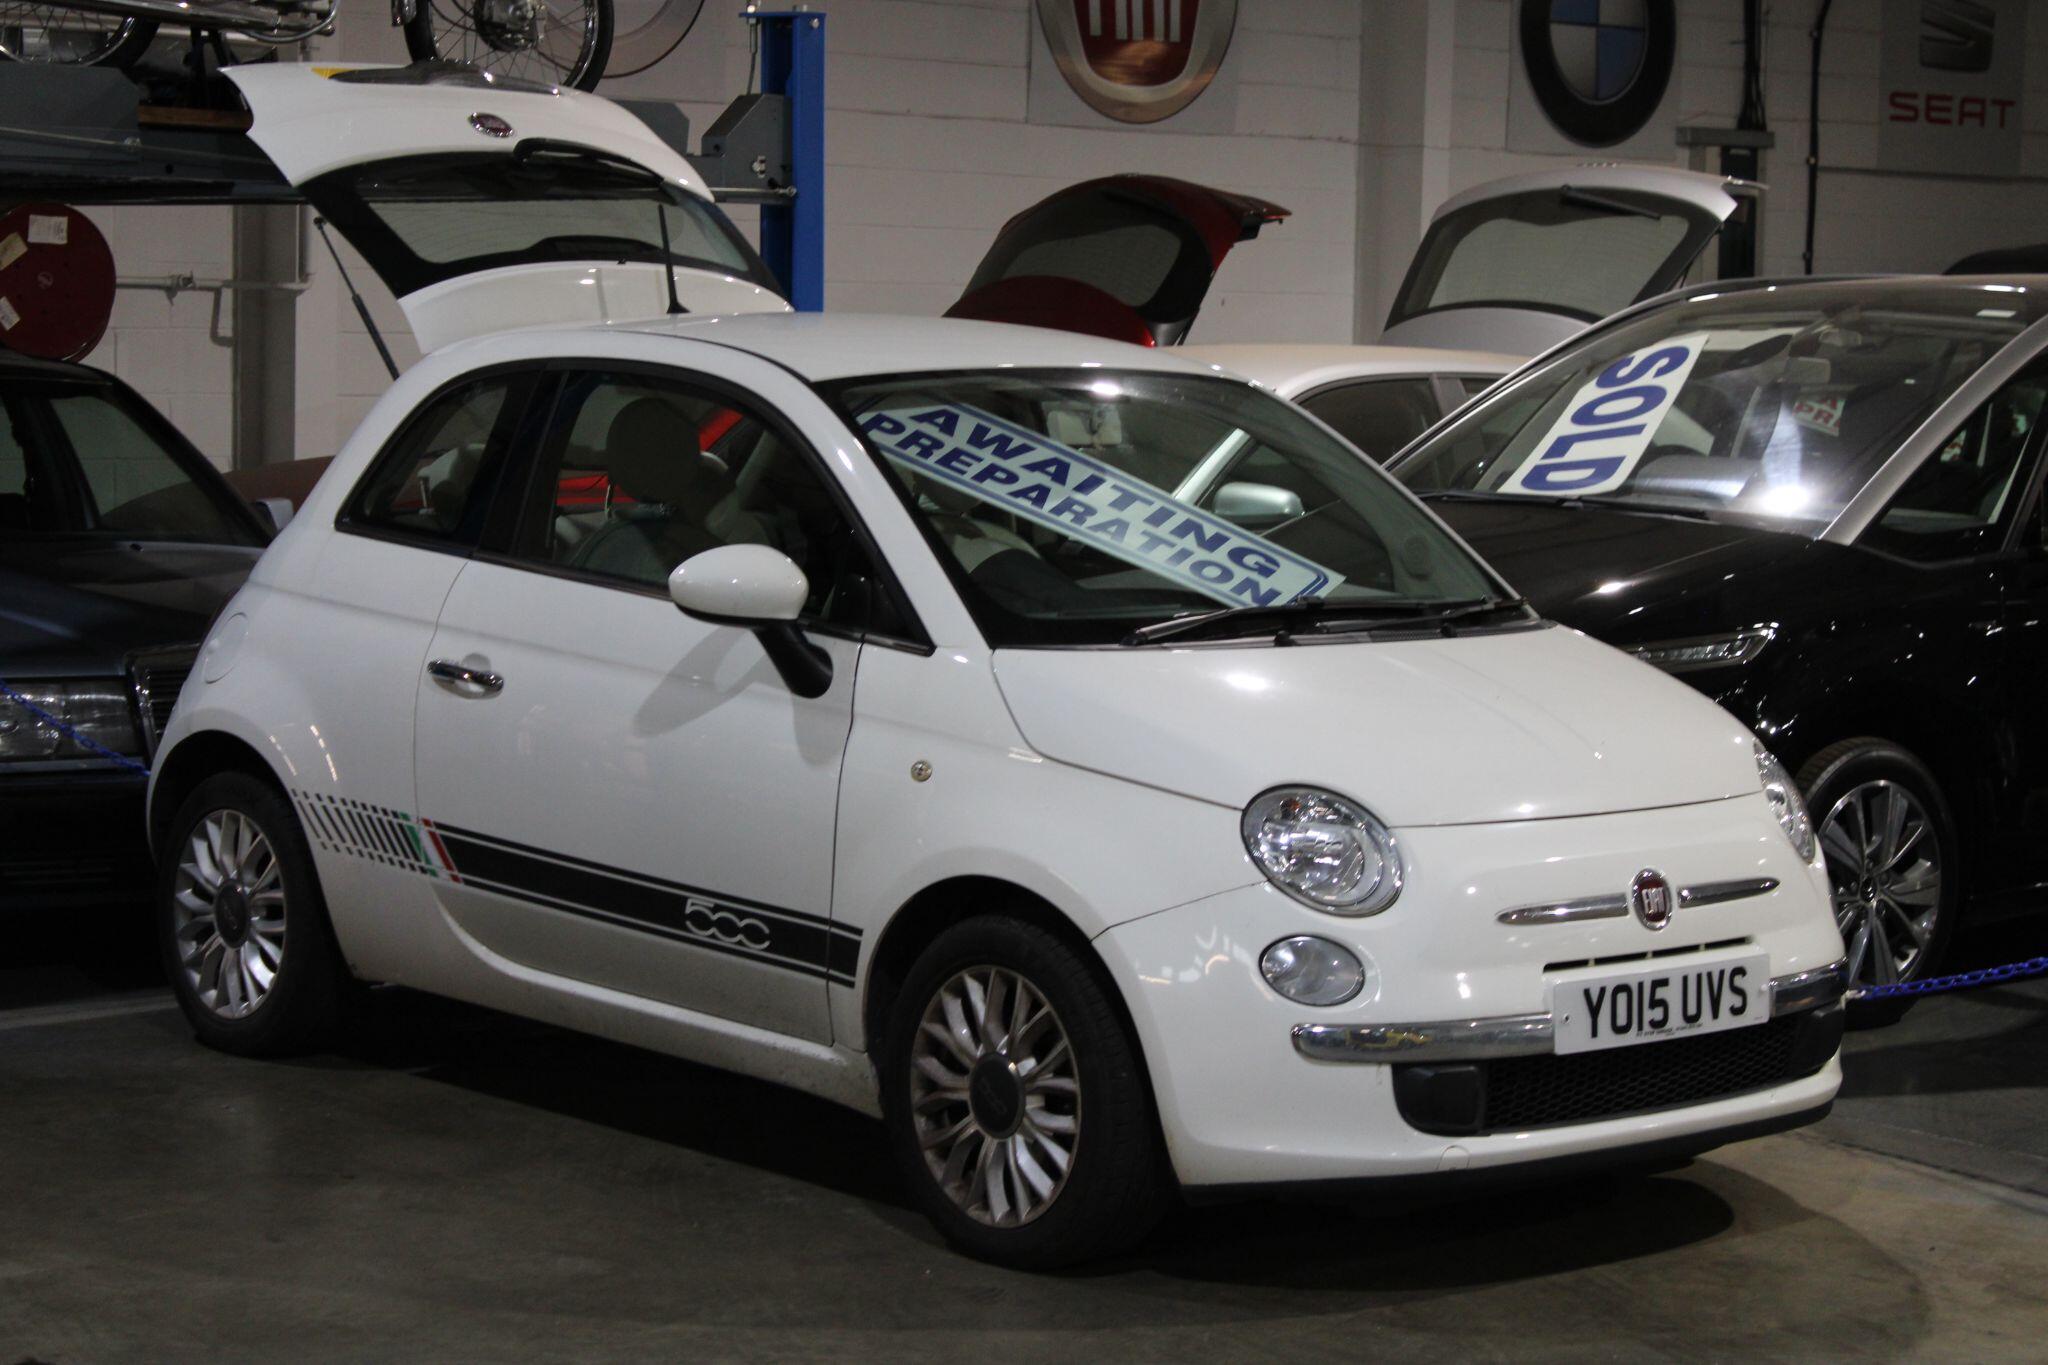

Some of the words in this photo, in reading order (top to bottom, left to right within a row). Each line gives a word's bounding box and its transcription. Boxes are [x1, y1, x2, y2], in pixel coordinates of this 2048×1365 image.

[1888, 91, 2017, 129] SEAT
[1520, 346, 1690, 491] SOLD
[861, 413, 1283, 607] PREPARATION
[908, 407, 1282, 579] AWAITING
[685, 898, 771, 950] 500
[1583, 977, 1670, 1039] YO15
[1681, 966, 1748, 1025] UVS
